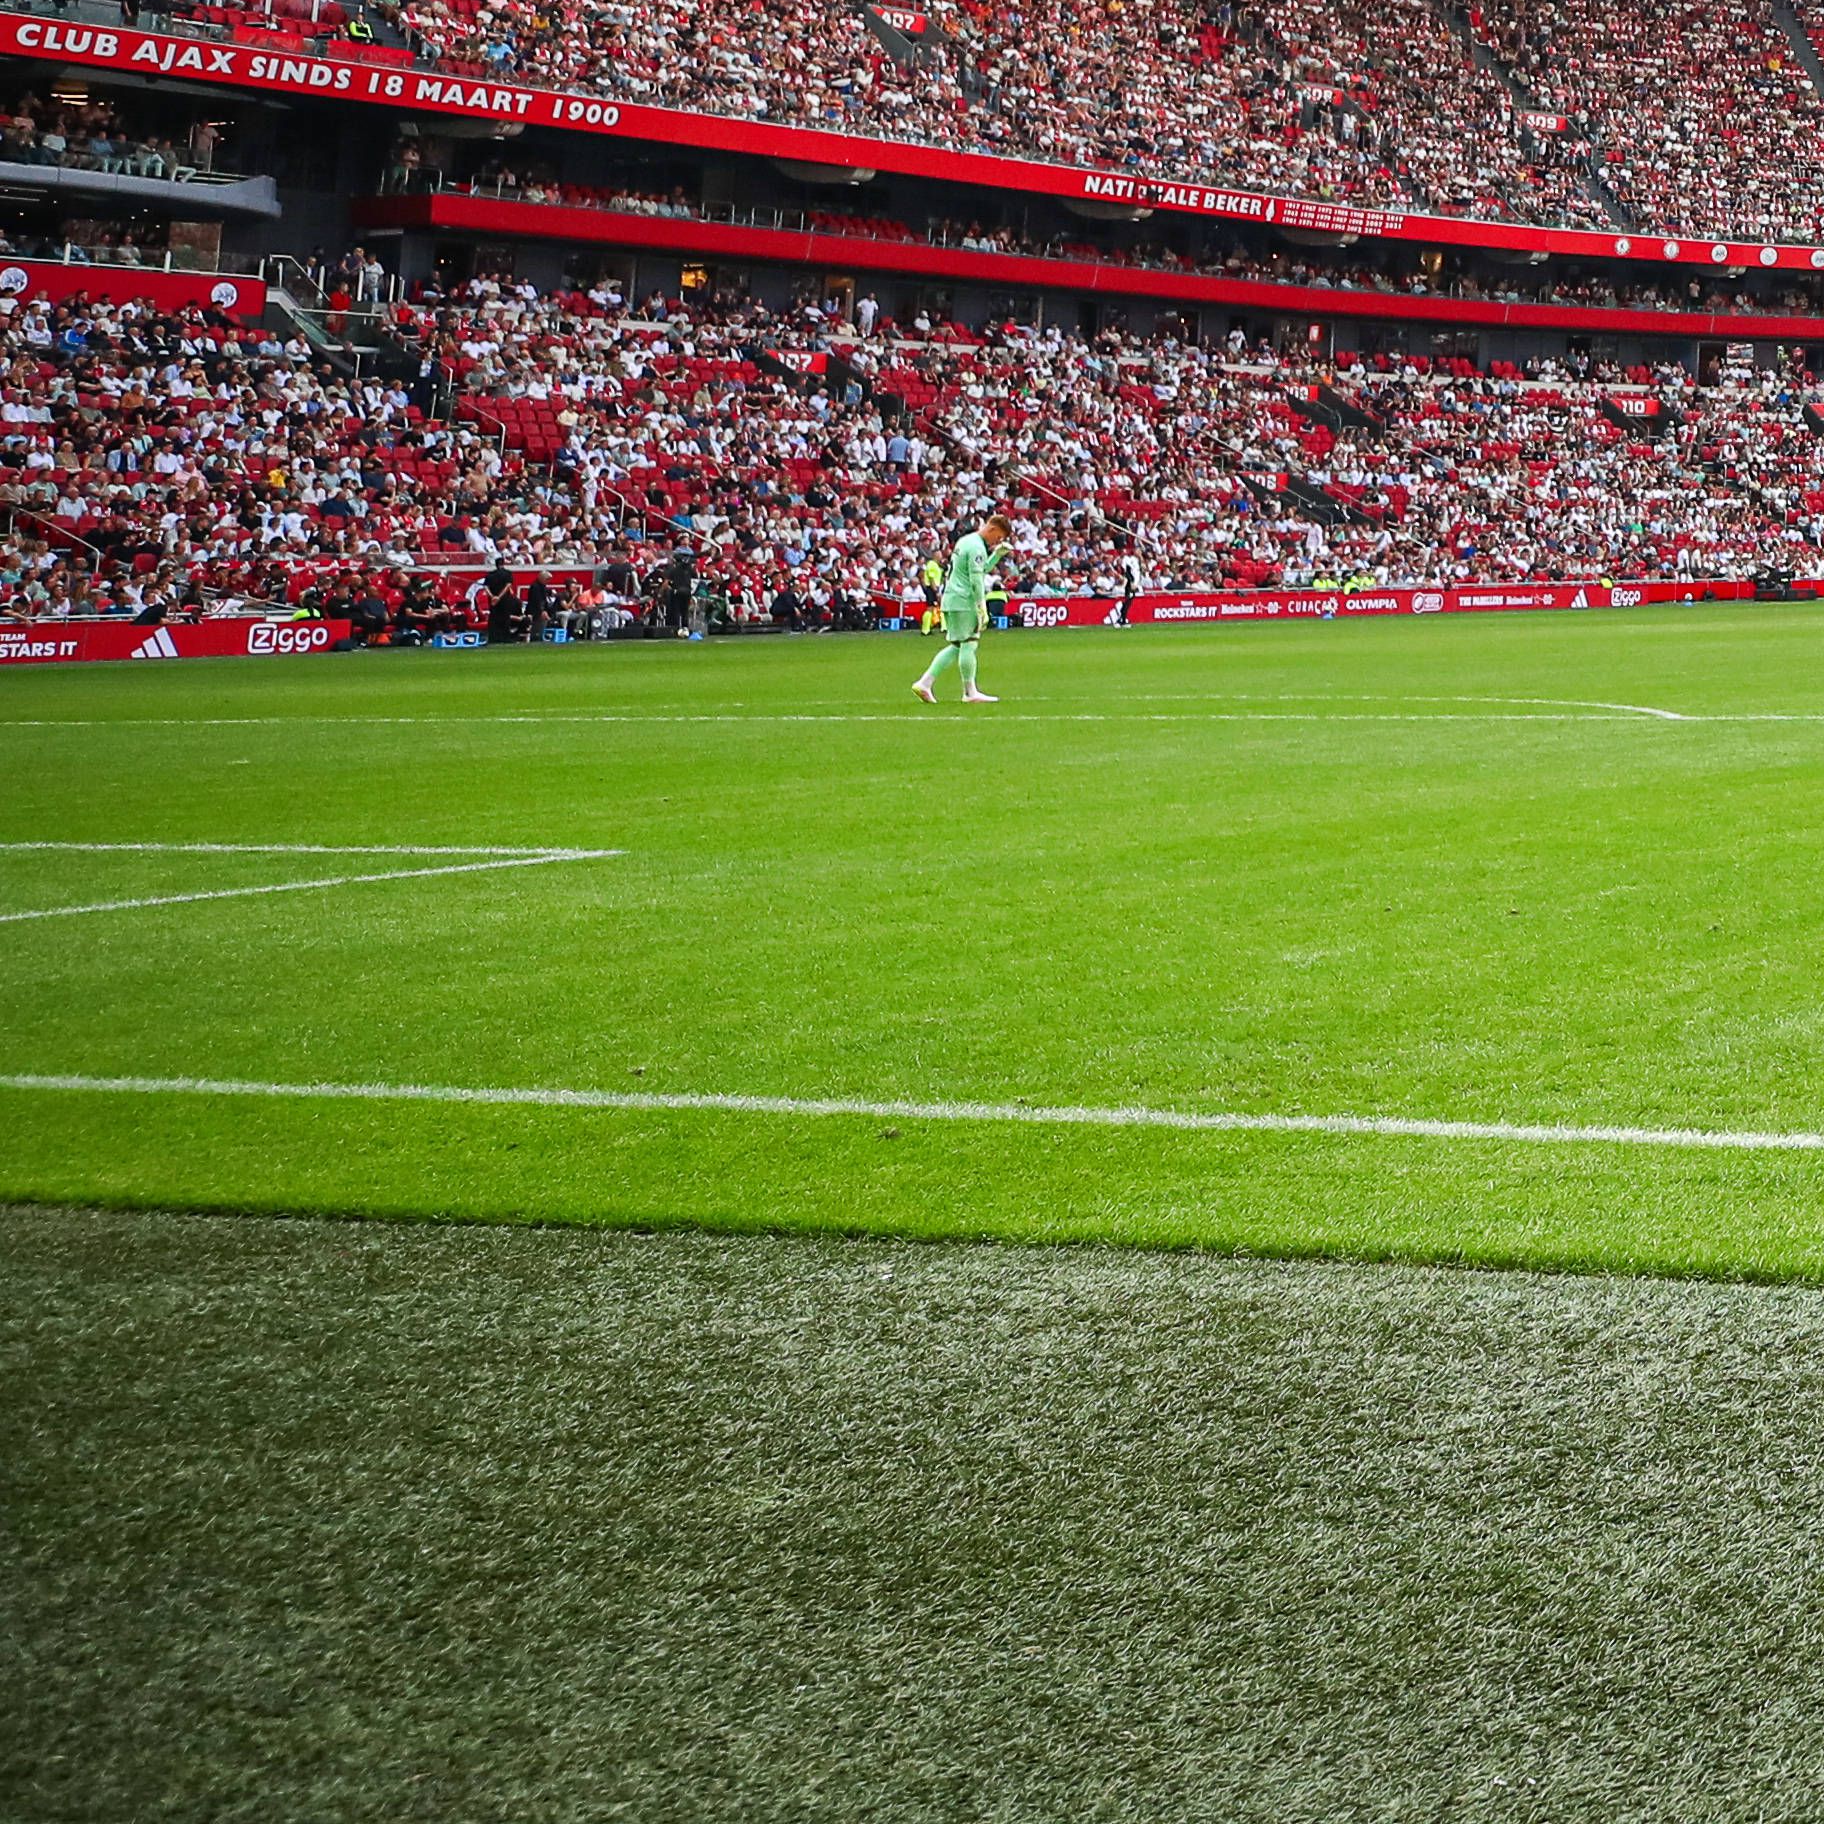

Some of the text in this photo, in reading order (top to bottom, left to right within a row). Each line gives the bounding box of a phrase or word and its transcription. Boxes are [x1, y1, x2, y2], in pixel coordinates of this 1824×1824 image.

[881, 12, 915, 30] 407
[16, 24, 619, 126] CLUB AJAX SINDS 18 MAART 1900
[1526, 114, 1557, 129] 409
[1203, 192, 1262, 216] BEKER
[778, 353, 813, 371] 107
[1621, 400, 1646, 414] 110
[1346, 598, 1398, 611] OLYMPIA
[1154, 606, 1218, 619] ROCKSTARS IT
[0, 642, 77, 657] STARS IT
